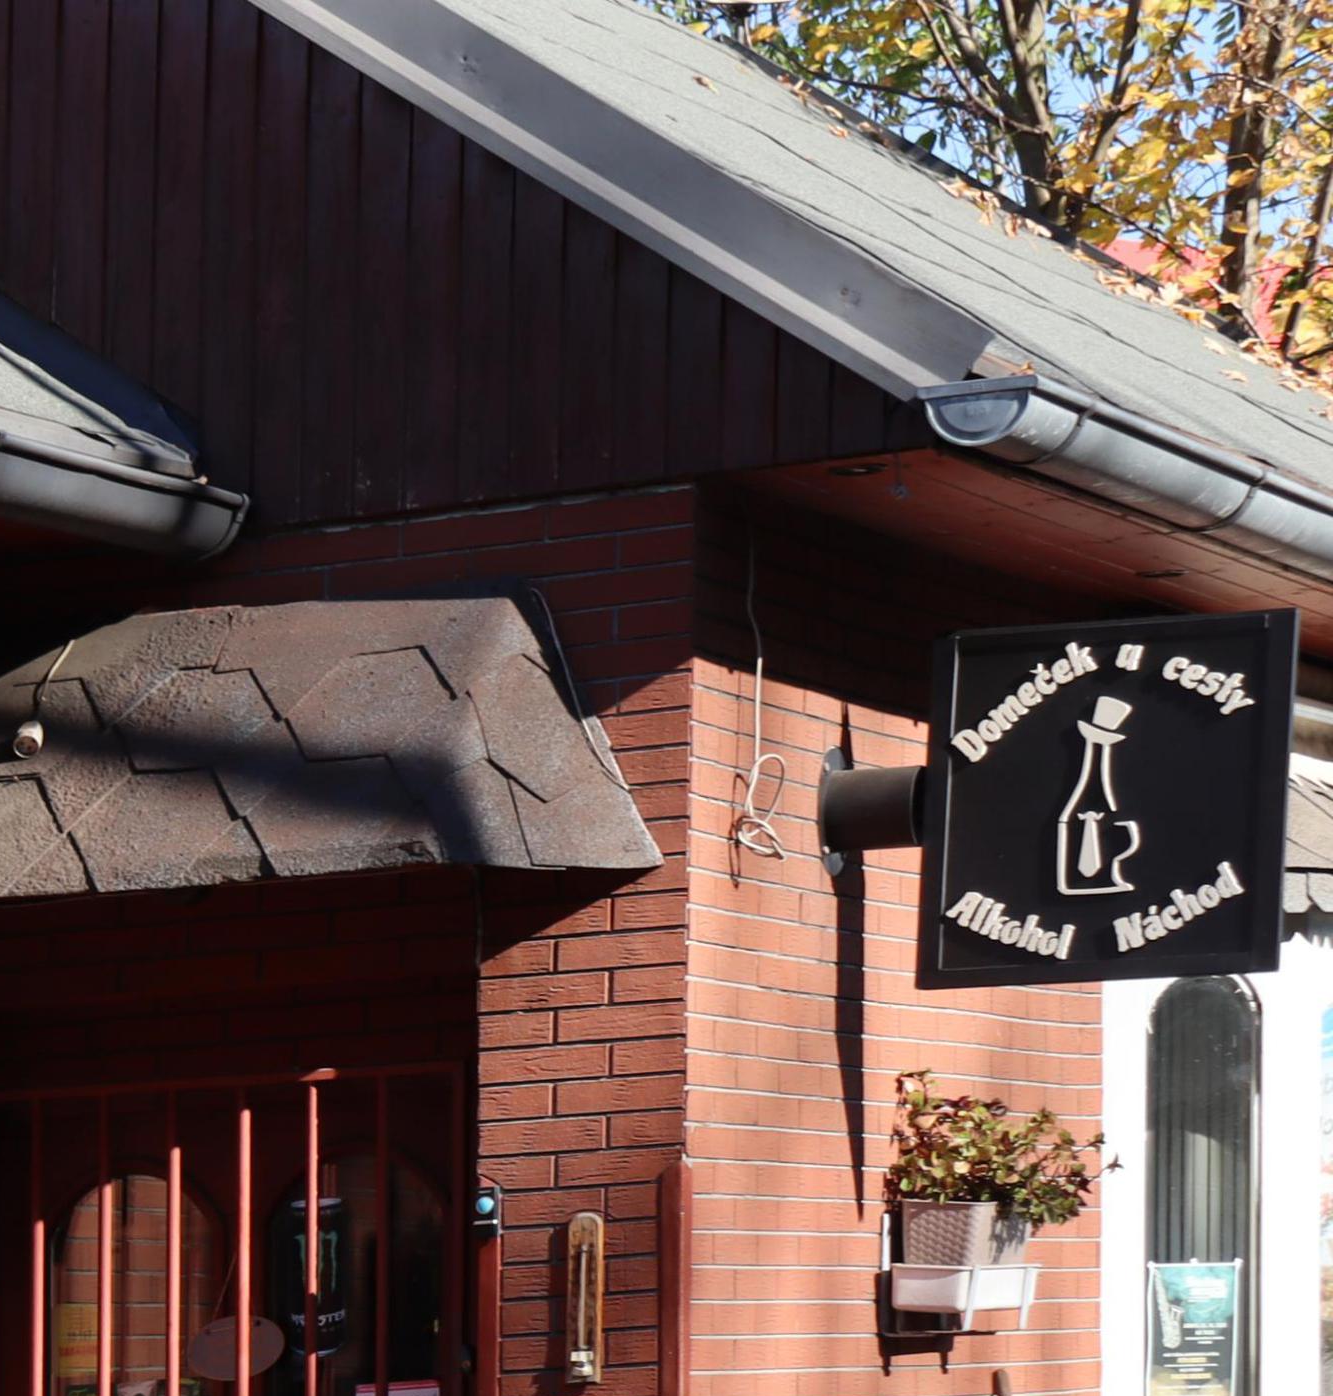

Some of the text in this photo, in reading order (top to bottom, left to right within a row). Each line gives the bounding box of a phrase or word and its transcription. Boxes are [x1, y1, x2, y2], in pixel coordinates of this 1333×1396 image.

[950, 641, 1255, 763] Domeček u cesty
[945, 860, 1245, 960] Alkohol Náchod
